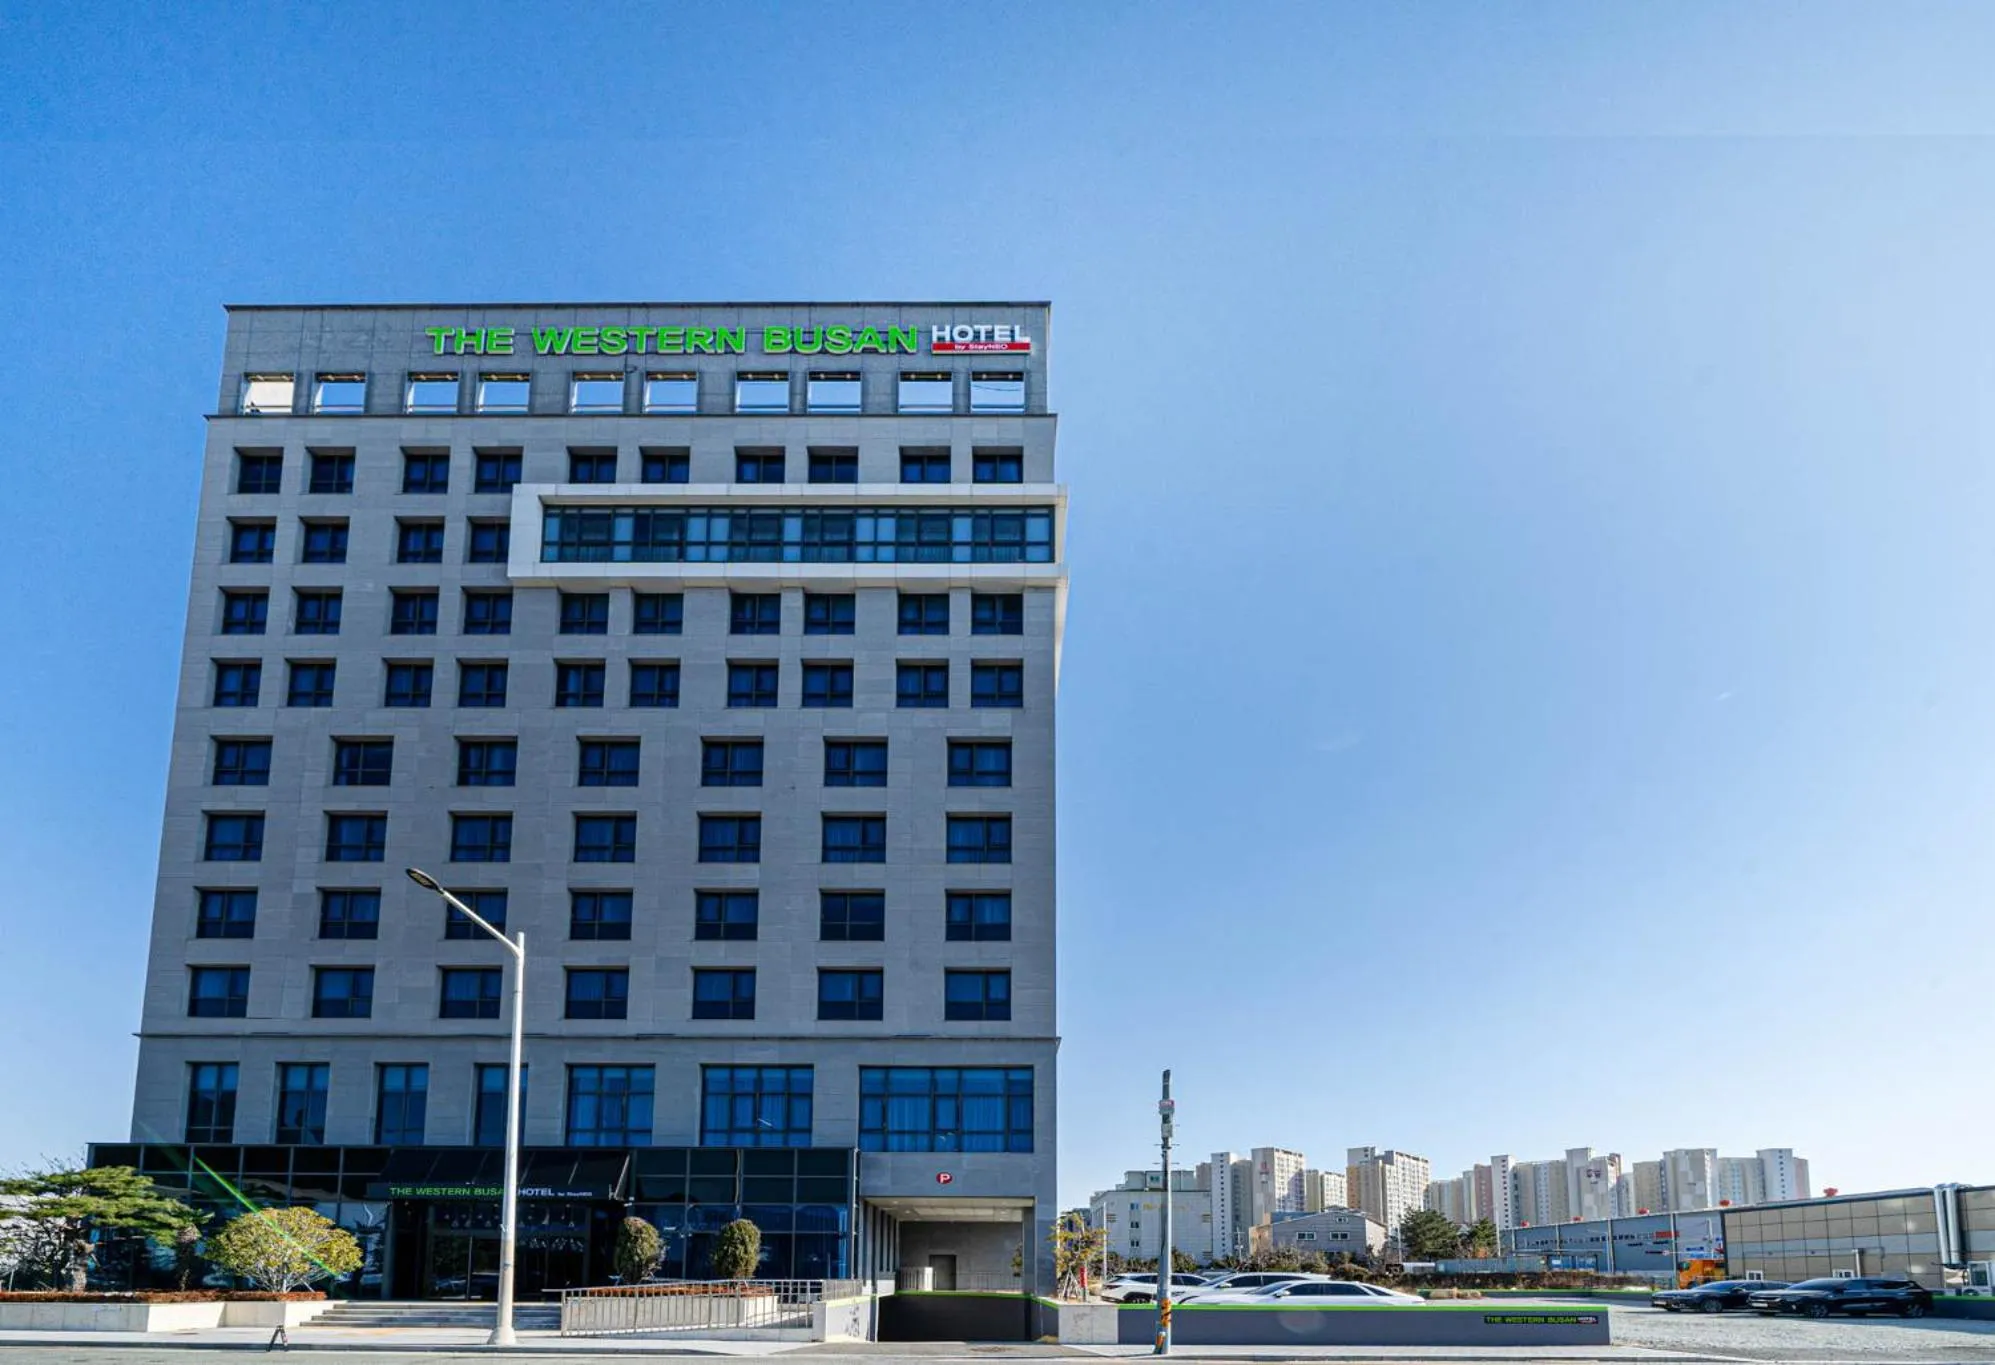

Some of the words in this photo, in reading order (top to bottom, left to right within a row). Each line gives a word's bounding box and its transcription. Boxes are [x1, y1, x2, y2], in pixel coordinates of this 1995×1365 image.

[425, 326, 515, 355] THE
[531, 326, 746, 355] WESTERN
[763, 325, 918, 355] BUSAN
[931, 324, 1031, 342] HOTEL
[940, 1173, 951, 1184] P
[389, 1187, 413, 1196] THE
[415, 1187, 471, 1196] WESTERN
[474, 1187, 504, 1196] BUSA
[518, 1187, 555, 1197] HOTEL
